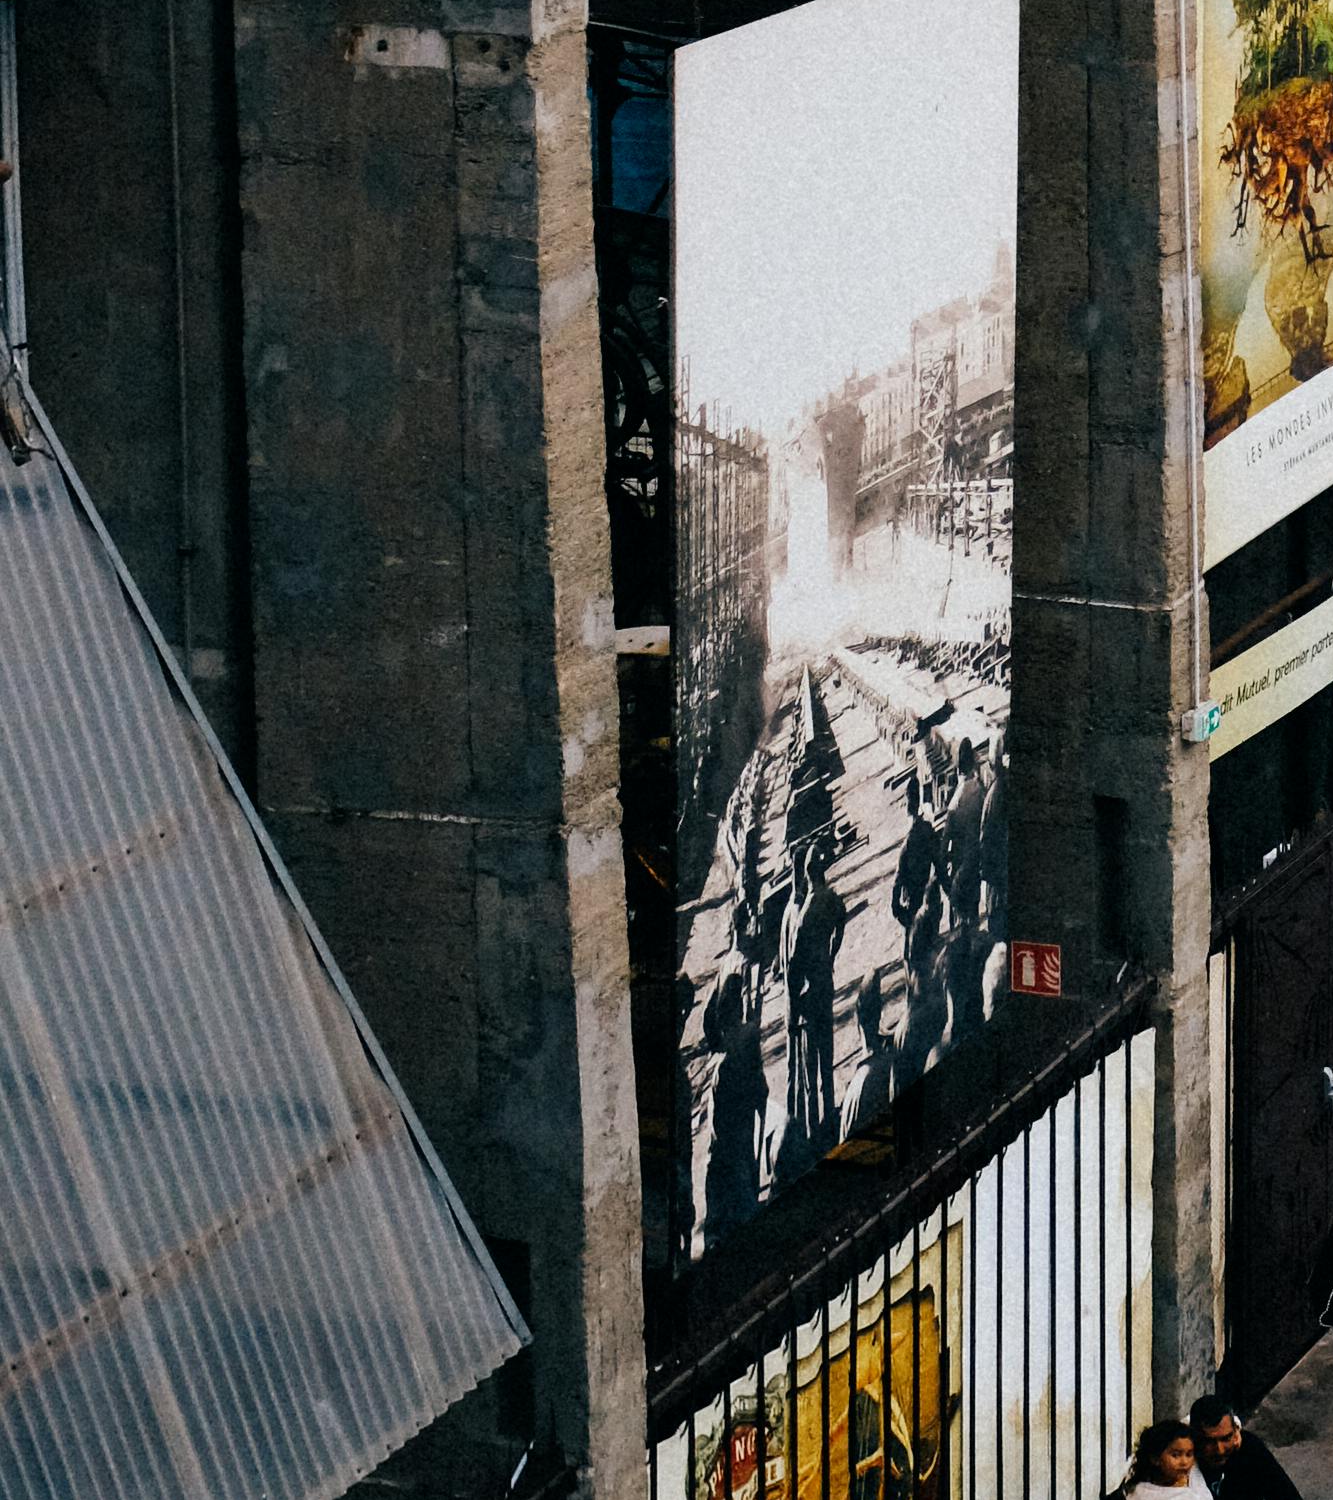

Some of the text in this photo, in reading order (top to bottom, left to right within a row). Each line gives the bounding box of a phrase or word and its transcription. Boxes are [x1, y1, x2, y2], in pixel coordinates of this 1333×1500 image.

[1246, 442, 1262, 467] LES
[1268, 409, 1312, 452] MONDES
[1219, 693, 1235, 717] dit
